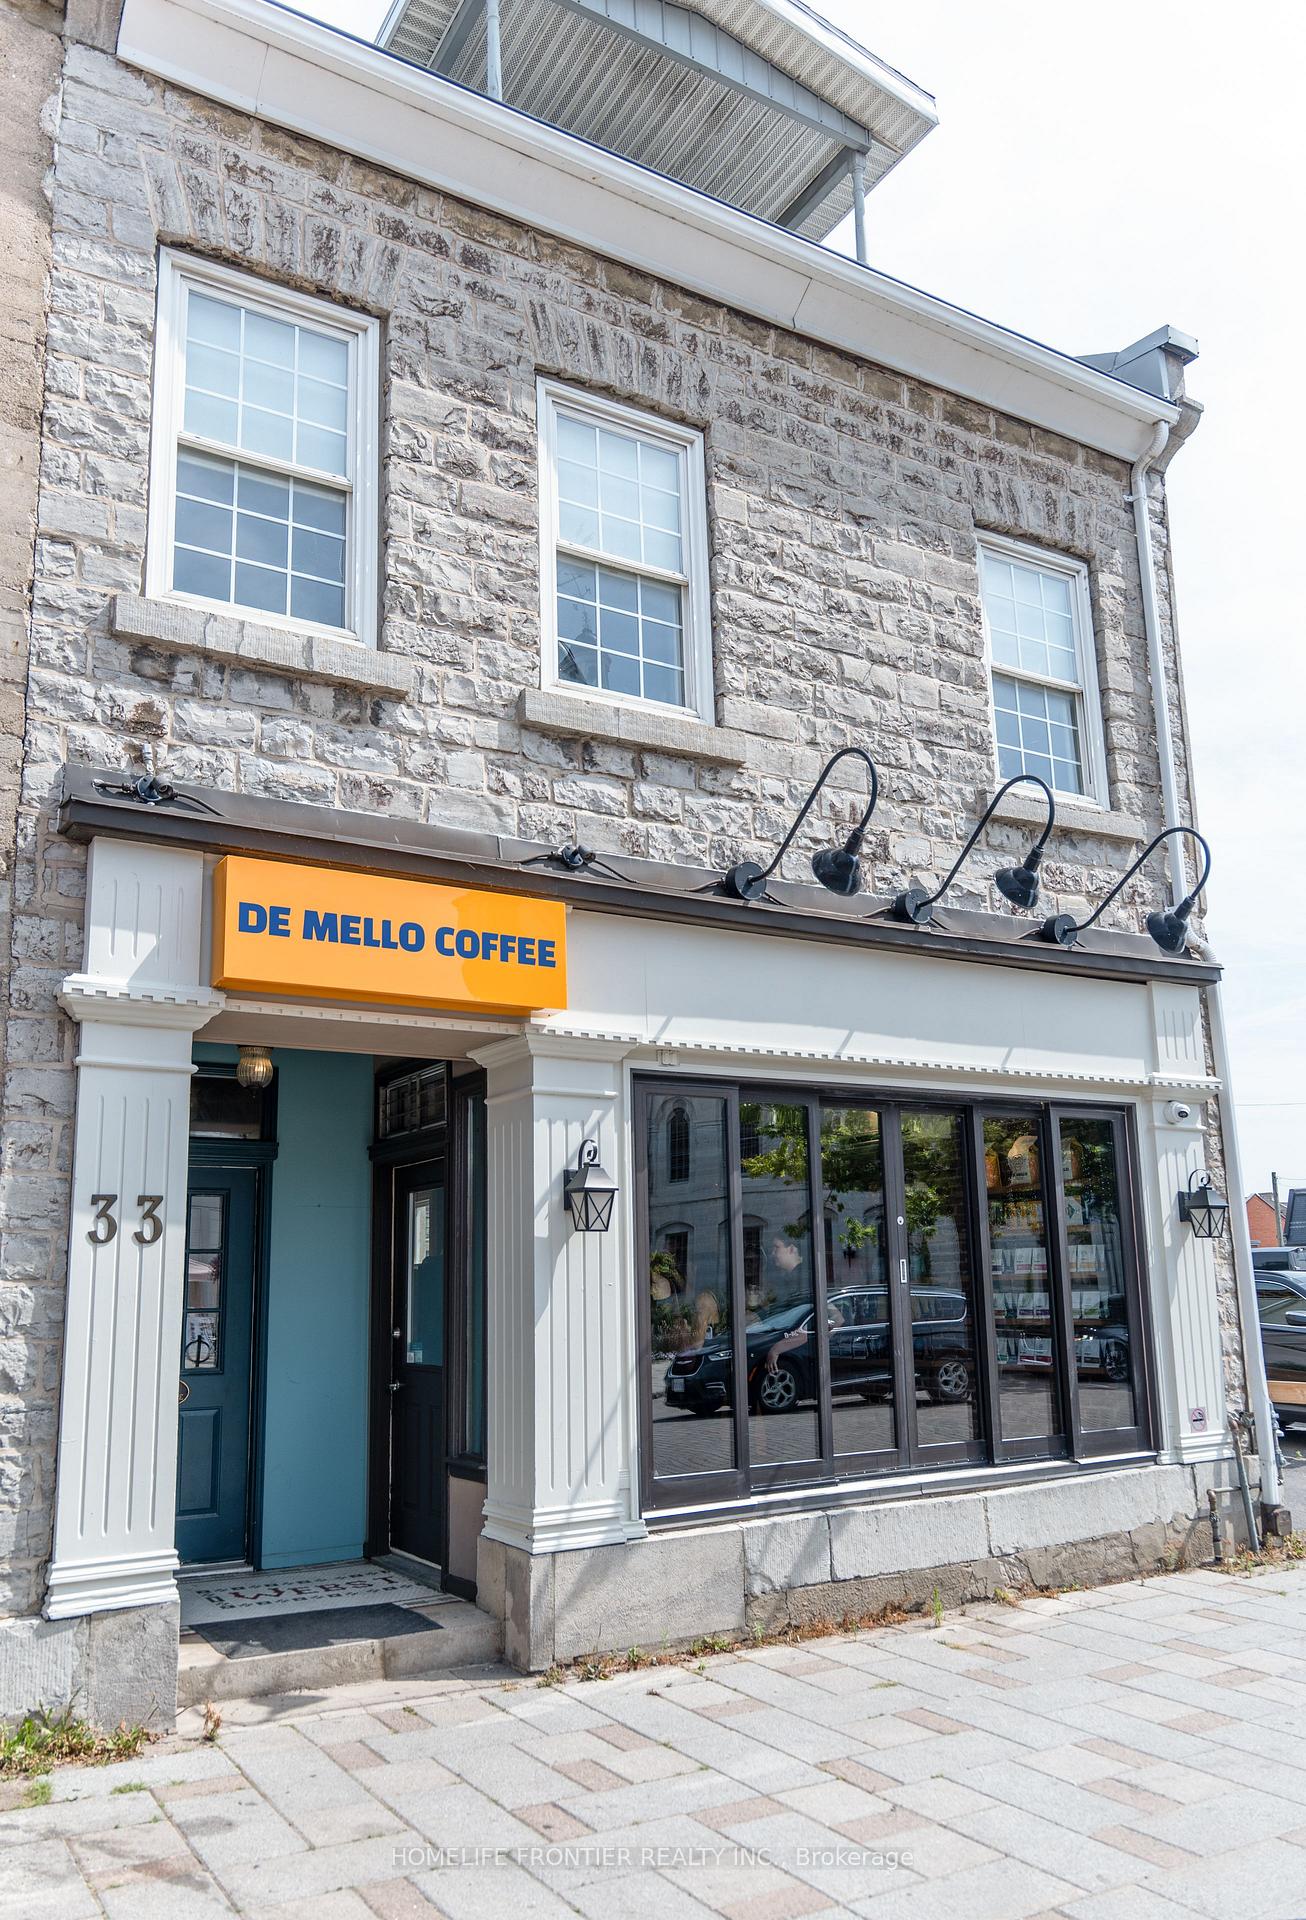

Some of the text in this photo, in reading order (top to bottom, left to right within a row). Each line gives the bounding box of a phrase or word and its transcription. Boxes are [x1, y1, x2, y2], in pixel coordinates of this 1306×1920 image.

[238, 901, 557, 968] DE MELLO COFFEE
[87, 1194, 164, 1244] 33
